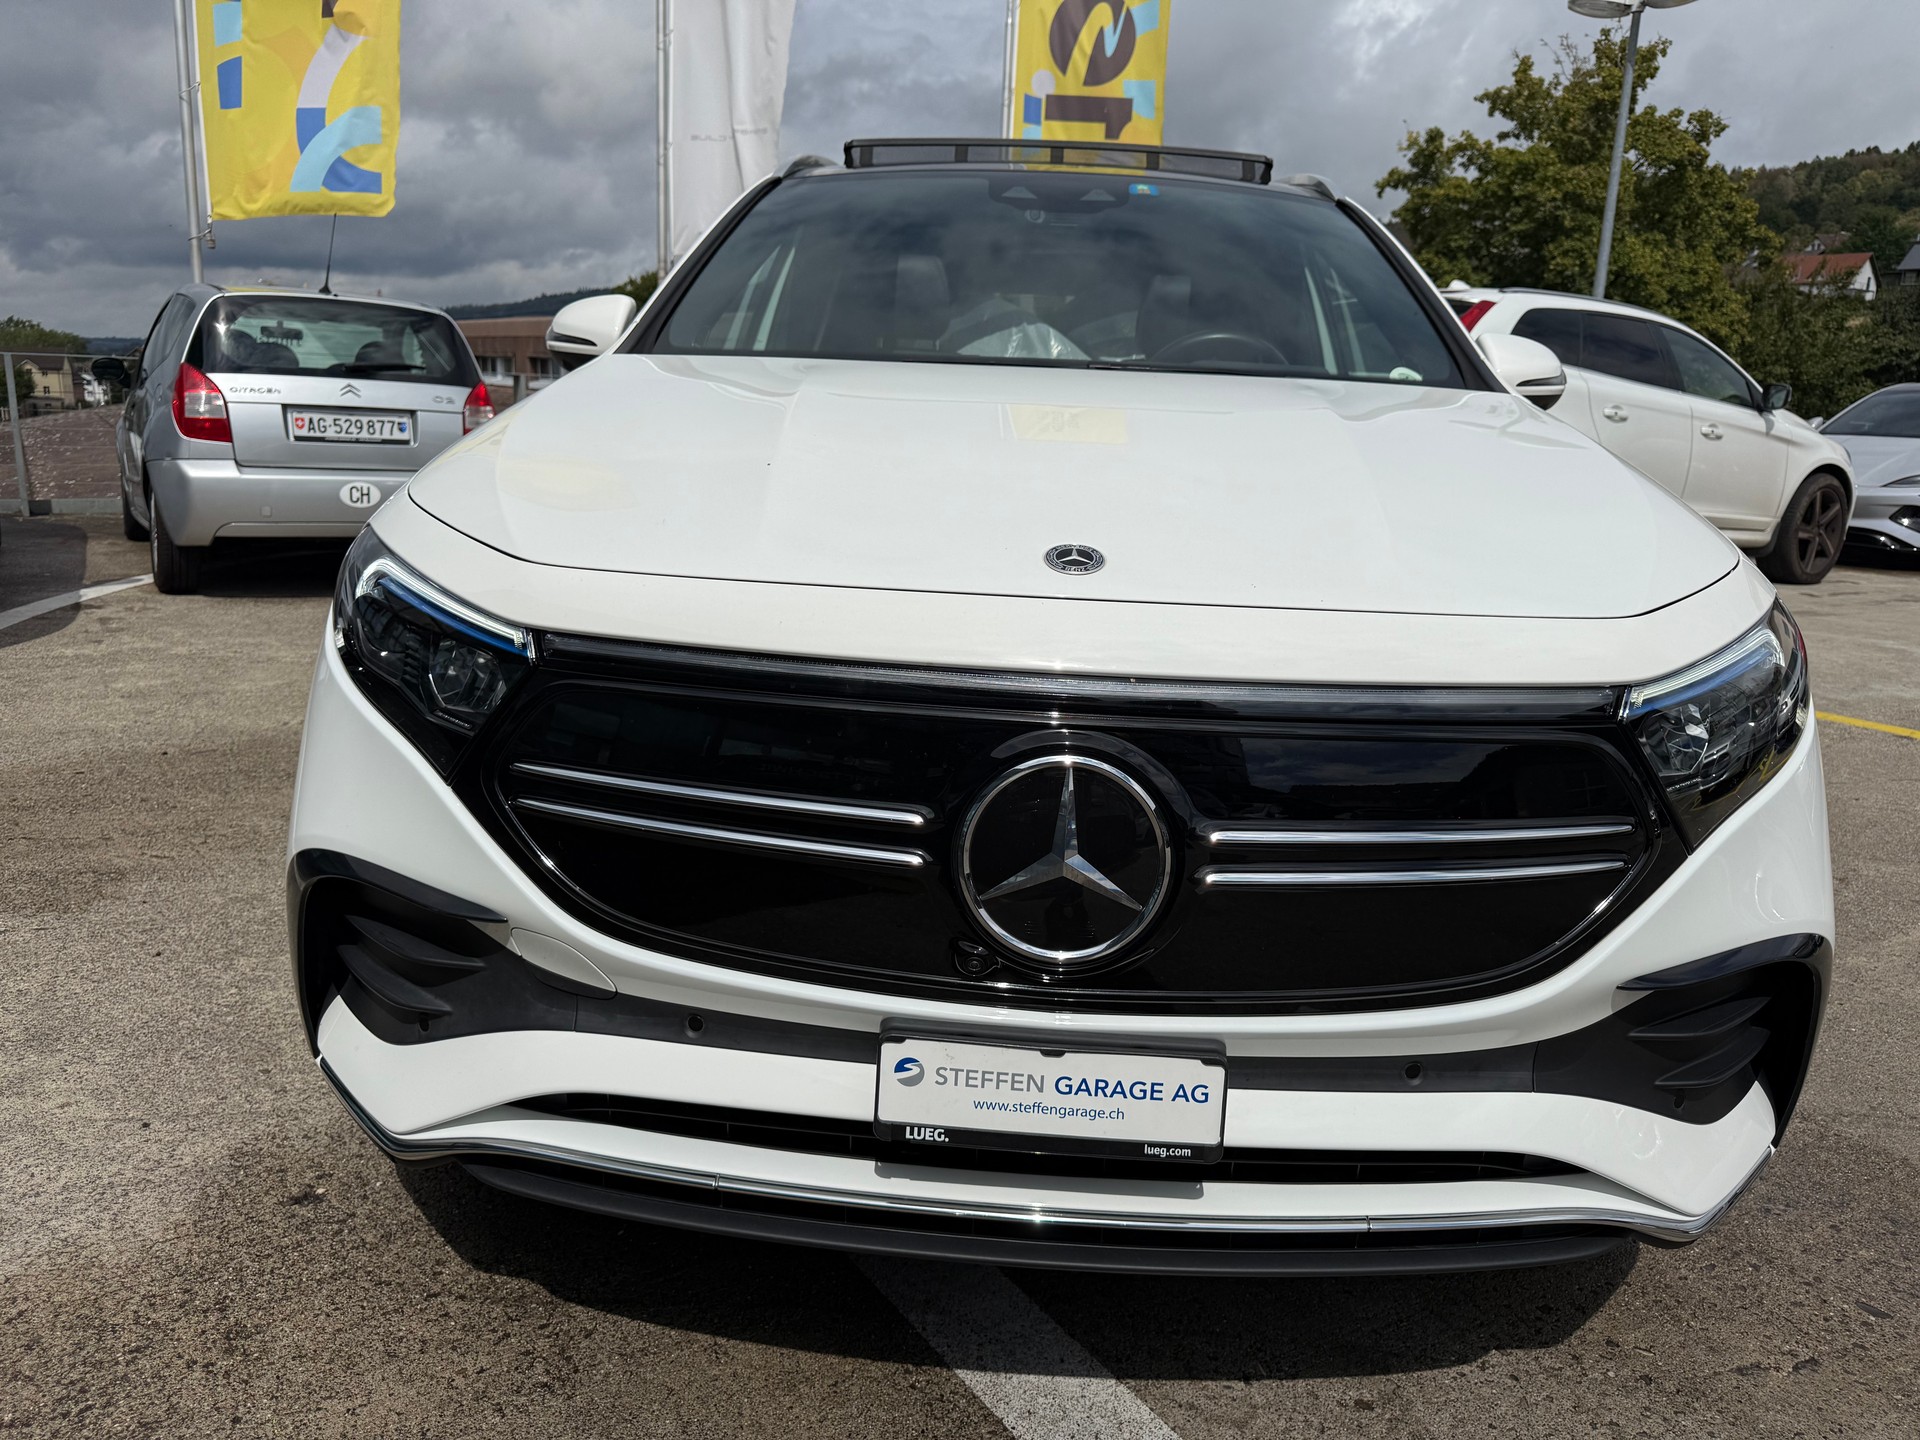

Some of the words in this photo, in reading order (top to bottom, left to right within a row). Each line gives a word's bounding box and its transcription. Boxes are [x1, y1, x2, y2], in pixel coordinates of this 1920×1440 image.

[349, 485, 371, 505] CH
[934, 1066, 1045, 1093] STEFFEN
[1054, 1075, 1164, 1102] GARAGE
[1170, 1083, 1210, 1104] AG
[973, 1100, 1125, 1120] www.steffengarage.ch
[905, 1126, 950, 1143] LUEG.
[1143, 1144, 1192, 1158] lueg.com
